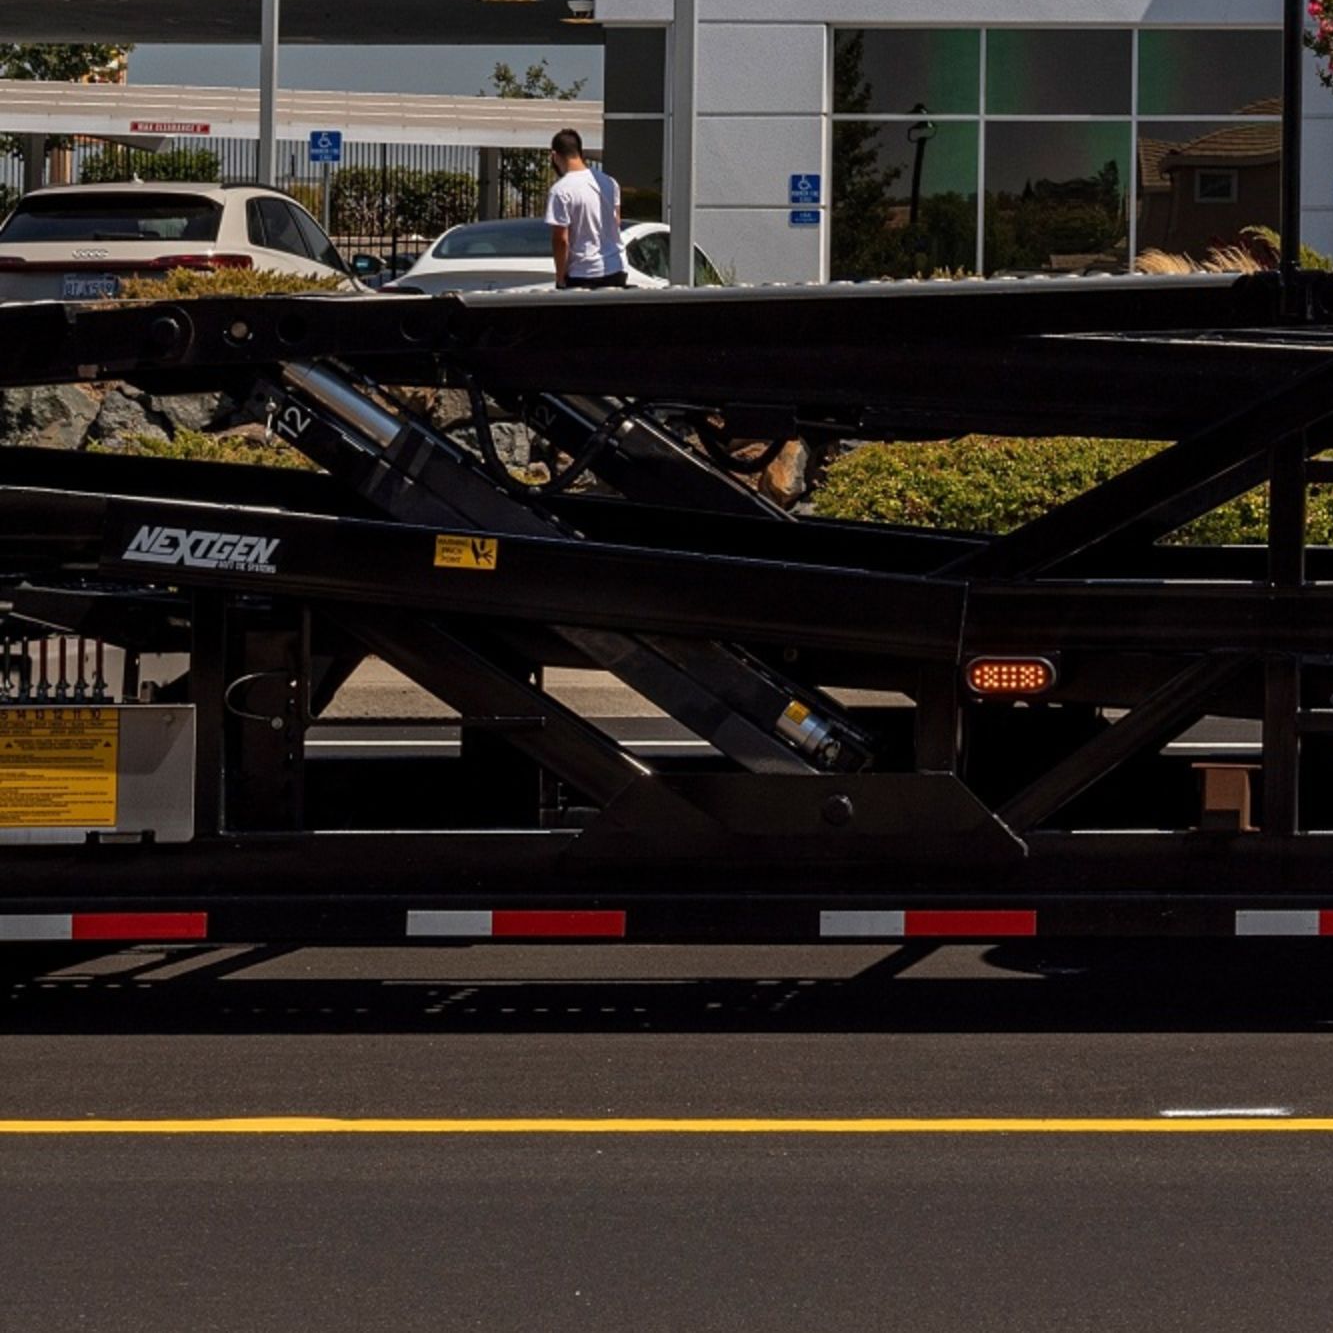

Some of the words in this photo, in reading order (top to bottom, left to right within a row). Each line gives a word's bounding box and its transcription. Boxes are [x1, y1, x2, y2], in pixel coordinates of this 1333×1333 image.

[277, 406, 311, 438] 12
[530, 405, 557, 430] 12
[122, 525, 281, 567] NEXTGEN
